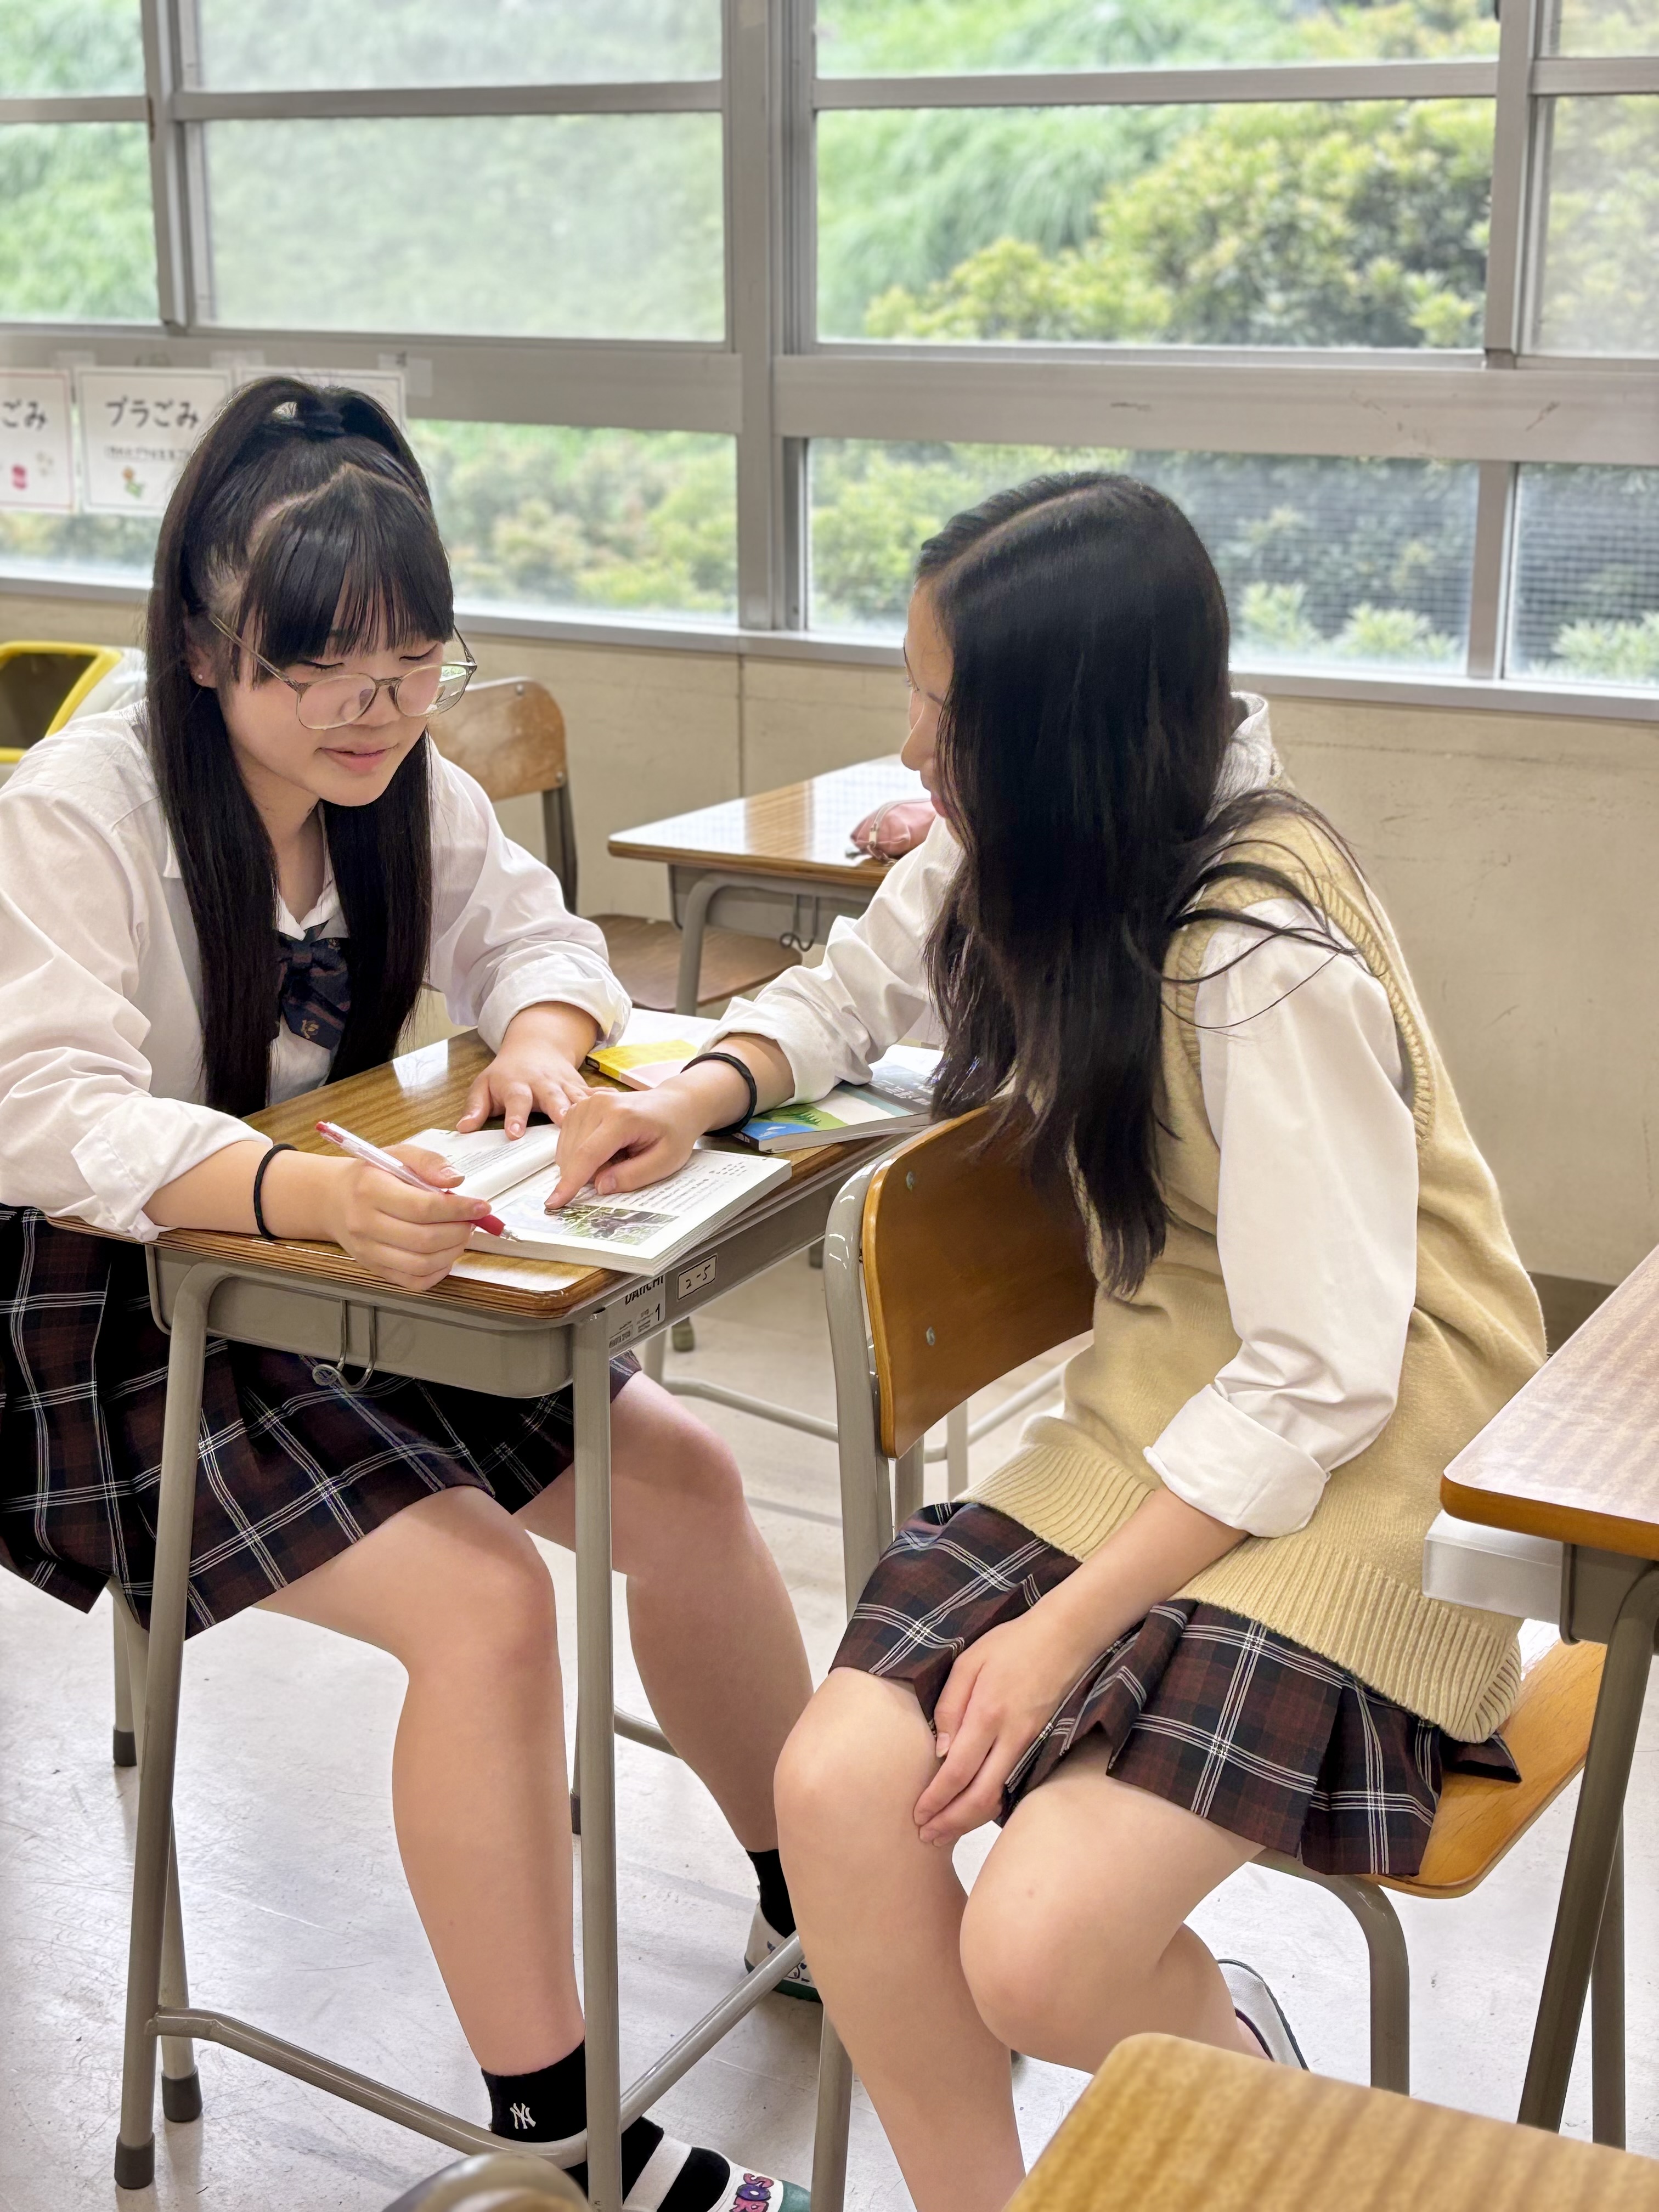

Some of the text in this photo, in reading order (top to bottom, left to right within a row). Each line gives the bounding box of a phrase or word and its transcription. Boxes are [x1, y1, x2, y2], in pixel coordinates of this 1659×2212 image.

[2, 399, 46, 430] ごみ
[106, 395, 200, 430] プラごみ
[655, 1303, 661, 1321] 1
[510, 2102, 536, 2129] NY
